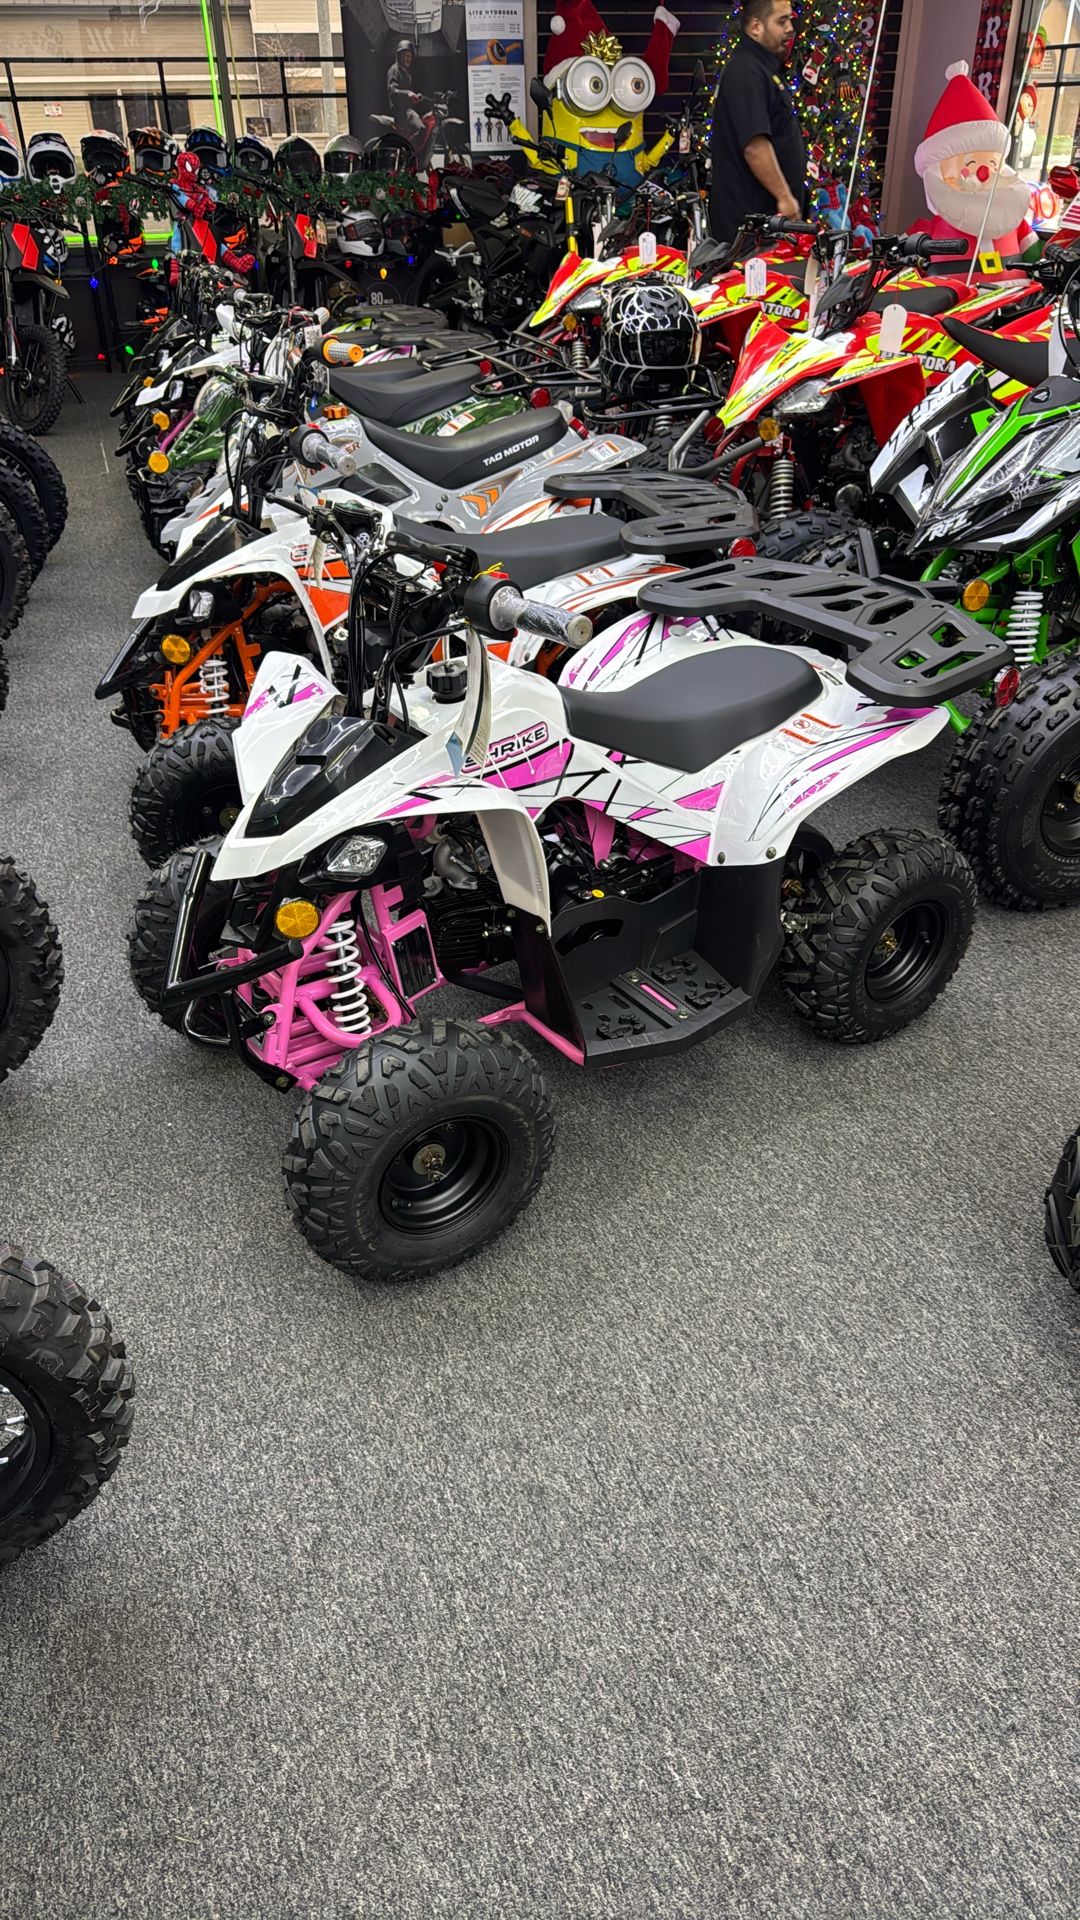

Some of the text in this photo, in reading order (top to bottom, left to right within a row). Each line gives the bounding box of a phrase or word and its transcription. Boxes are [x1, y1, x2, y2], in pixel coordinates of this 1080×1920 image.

[370, 291, 384, 305] 80
[482, 434, 540, 467] TAO MOTOR
